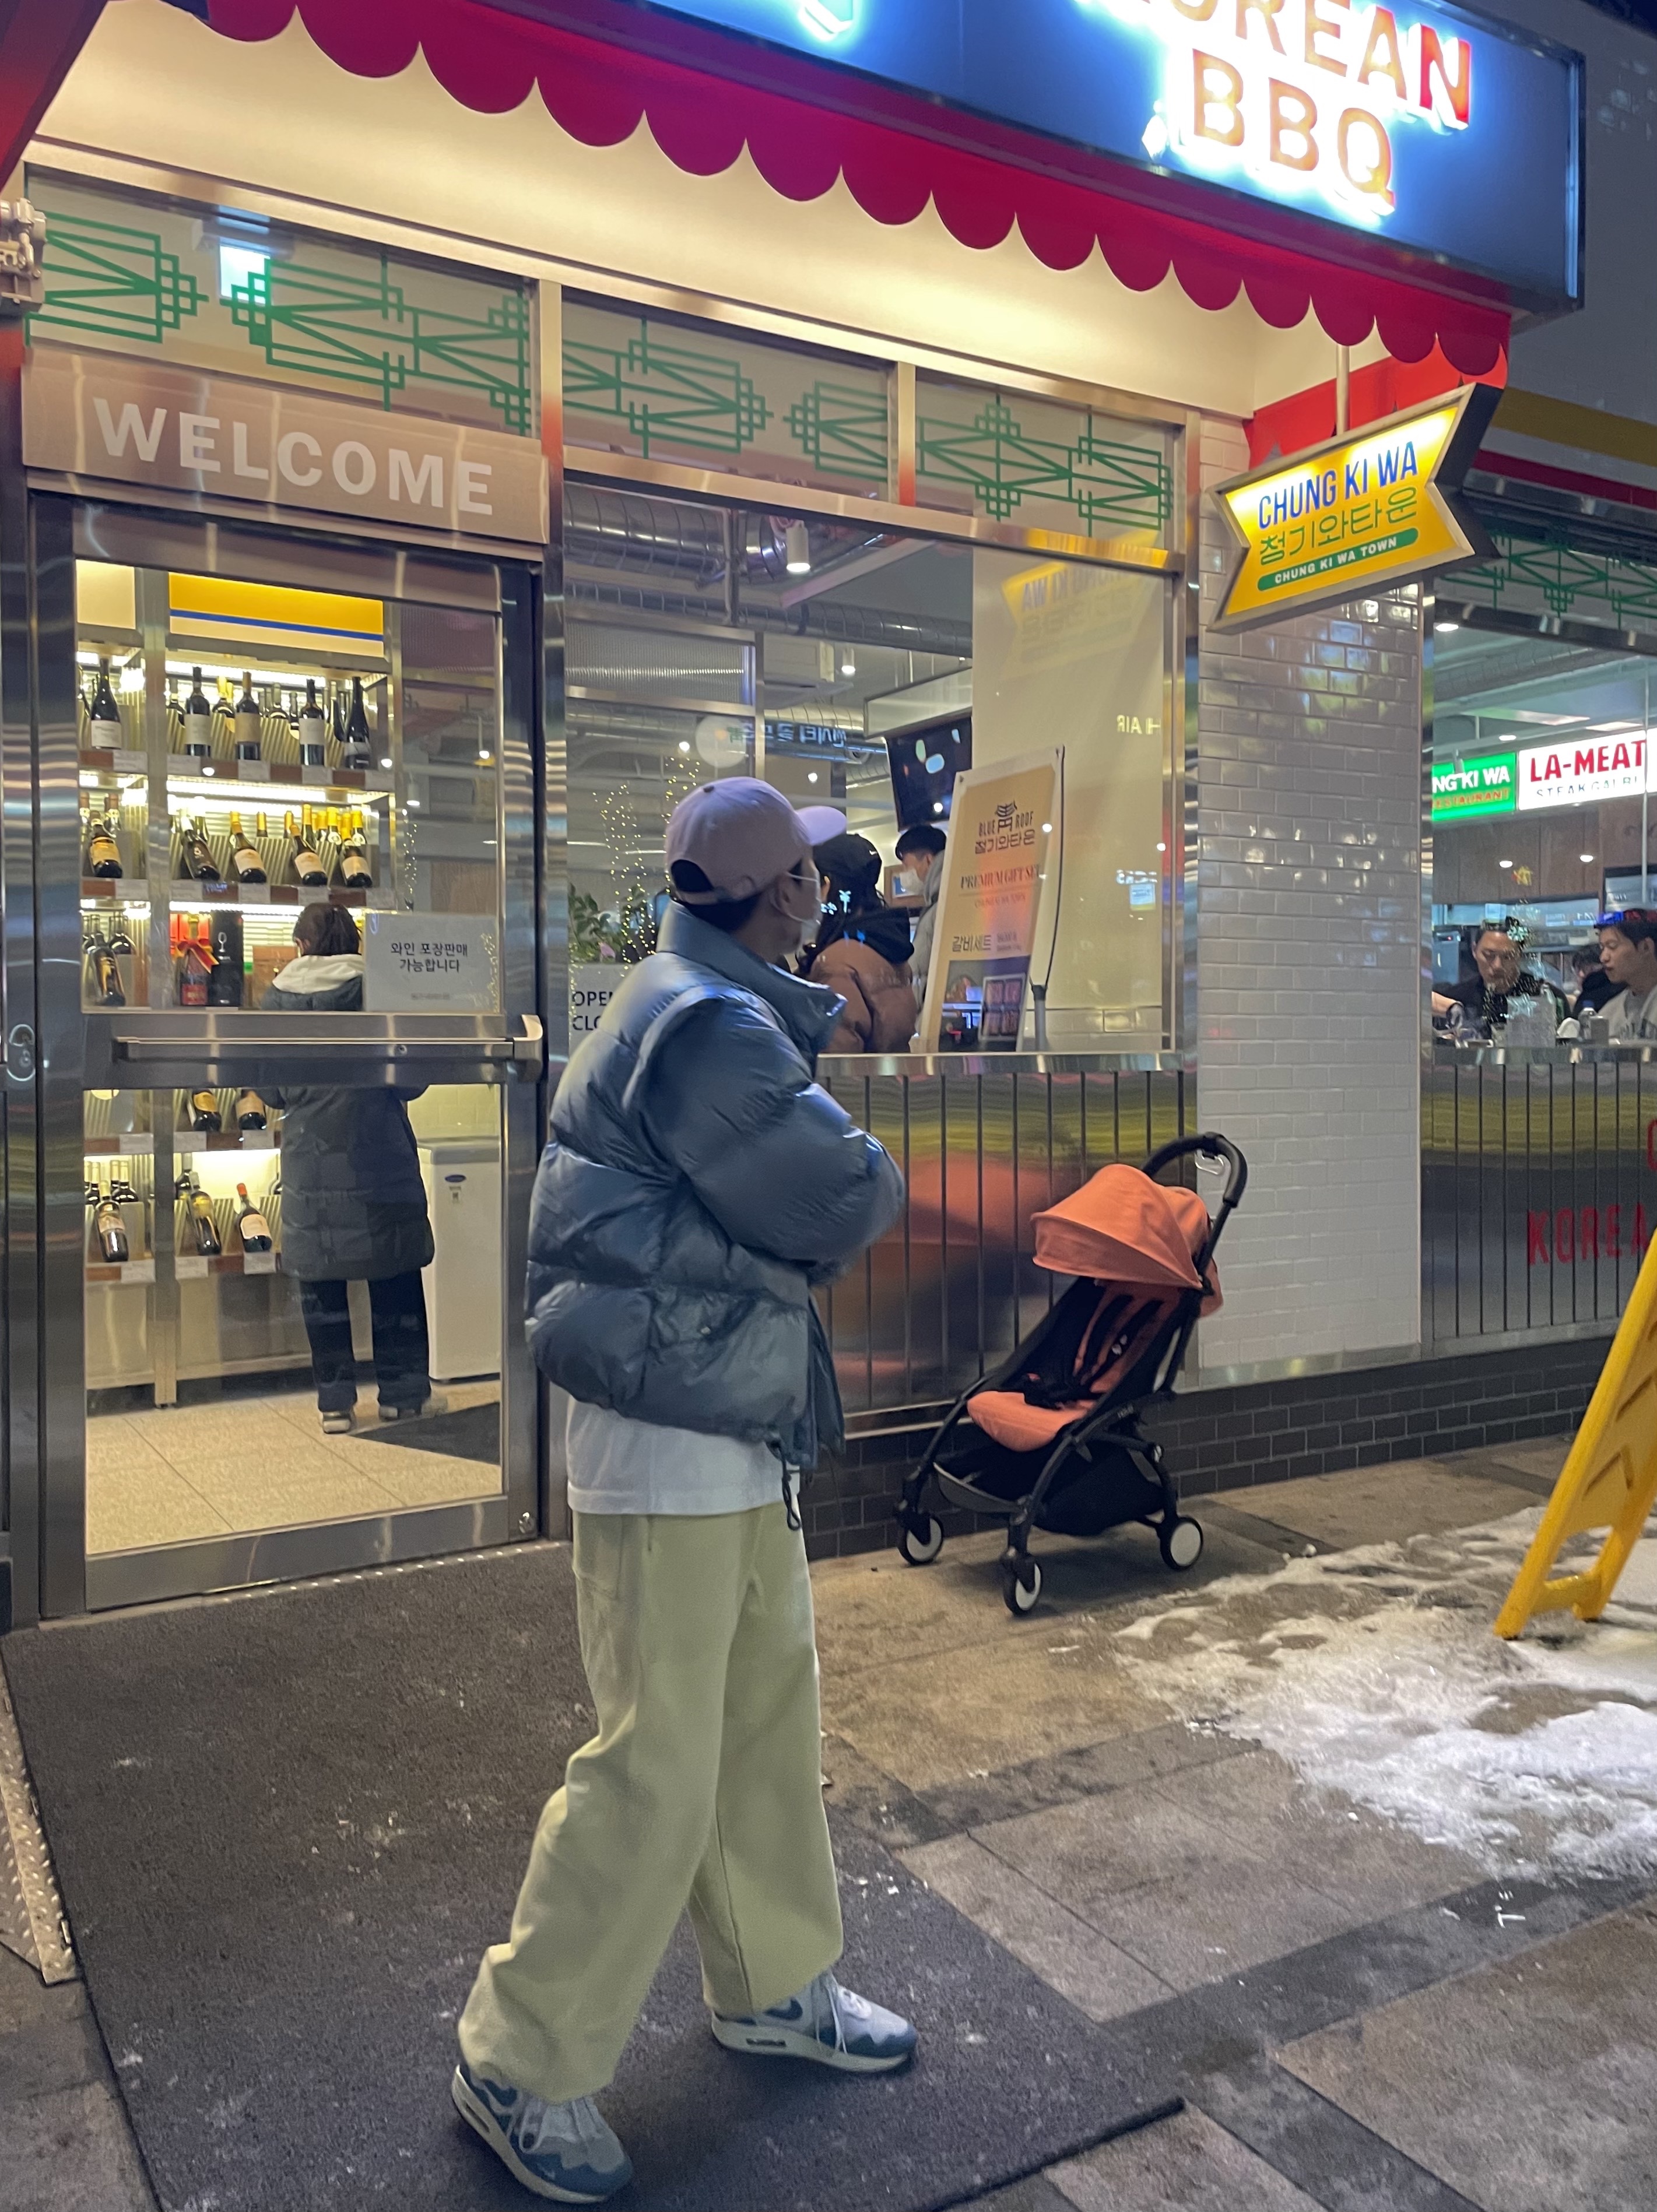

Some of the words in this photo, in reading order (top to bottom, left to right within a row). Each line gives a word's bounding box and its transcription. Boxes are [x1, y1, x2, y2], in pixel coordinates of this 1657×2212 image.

[1192, 48, 1395, 207] BBQ
[93, 397, 493, 515] WELCOME
[1259, 470, 1336, 529] CHUNG
[1344, 458, 1368, 500] KI
[1378, 441, 1418, 488] WA
[1259, 487, 1417, 565] 청기와타운
[1275, 563, 1315, 583] CHUNG
[1320, 558, 1333, 569] KI
[1337, 550, 1356, 564] WA
[1360, 536, 1397, 557] TOWN
[1461, 769, 1479, 789] KI
[1483, 765, 1510, 786] WA
[1530, 740, 1647, 782] LA-MEAT
[1430, 788, 1509, 809] ESTAURANT
[978, 819, 995, 837] BLUE
[1015, 811, 1034, 829] ROOF
[391, 941, 415, 956] 와인
[420, 943, 468, 957] 포장판매
[399, 958, 460, 973] 가능합니다
